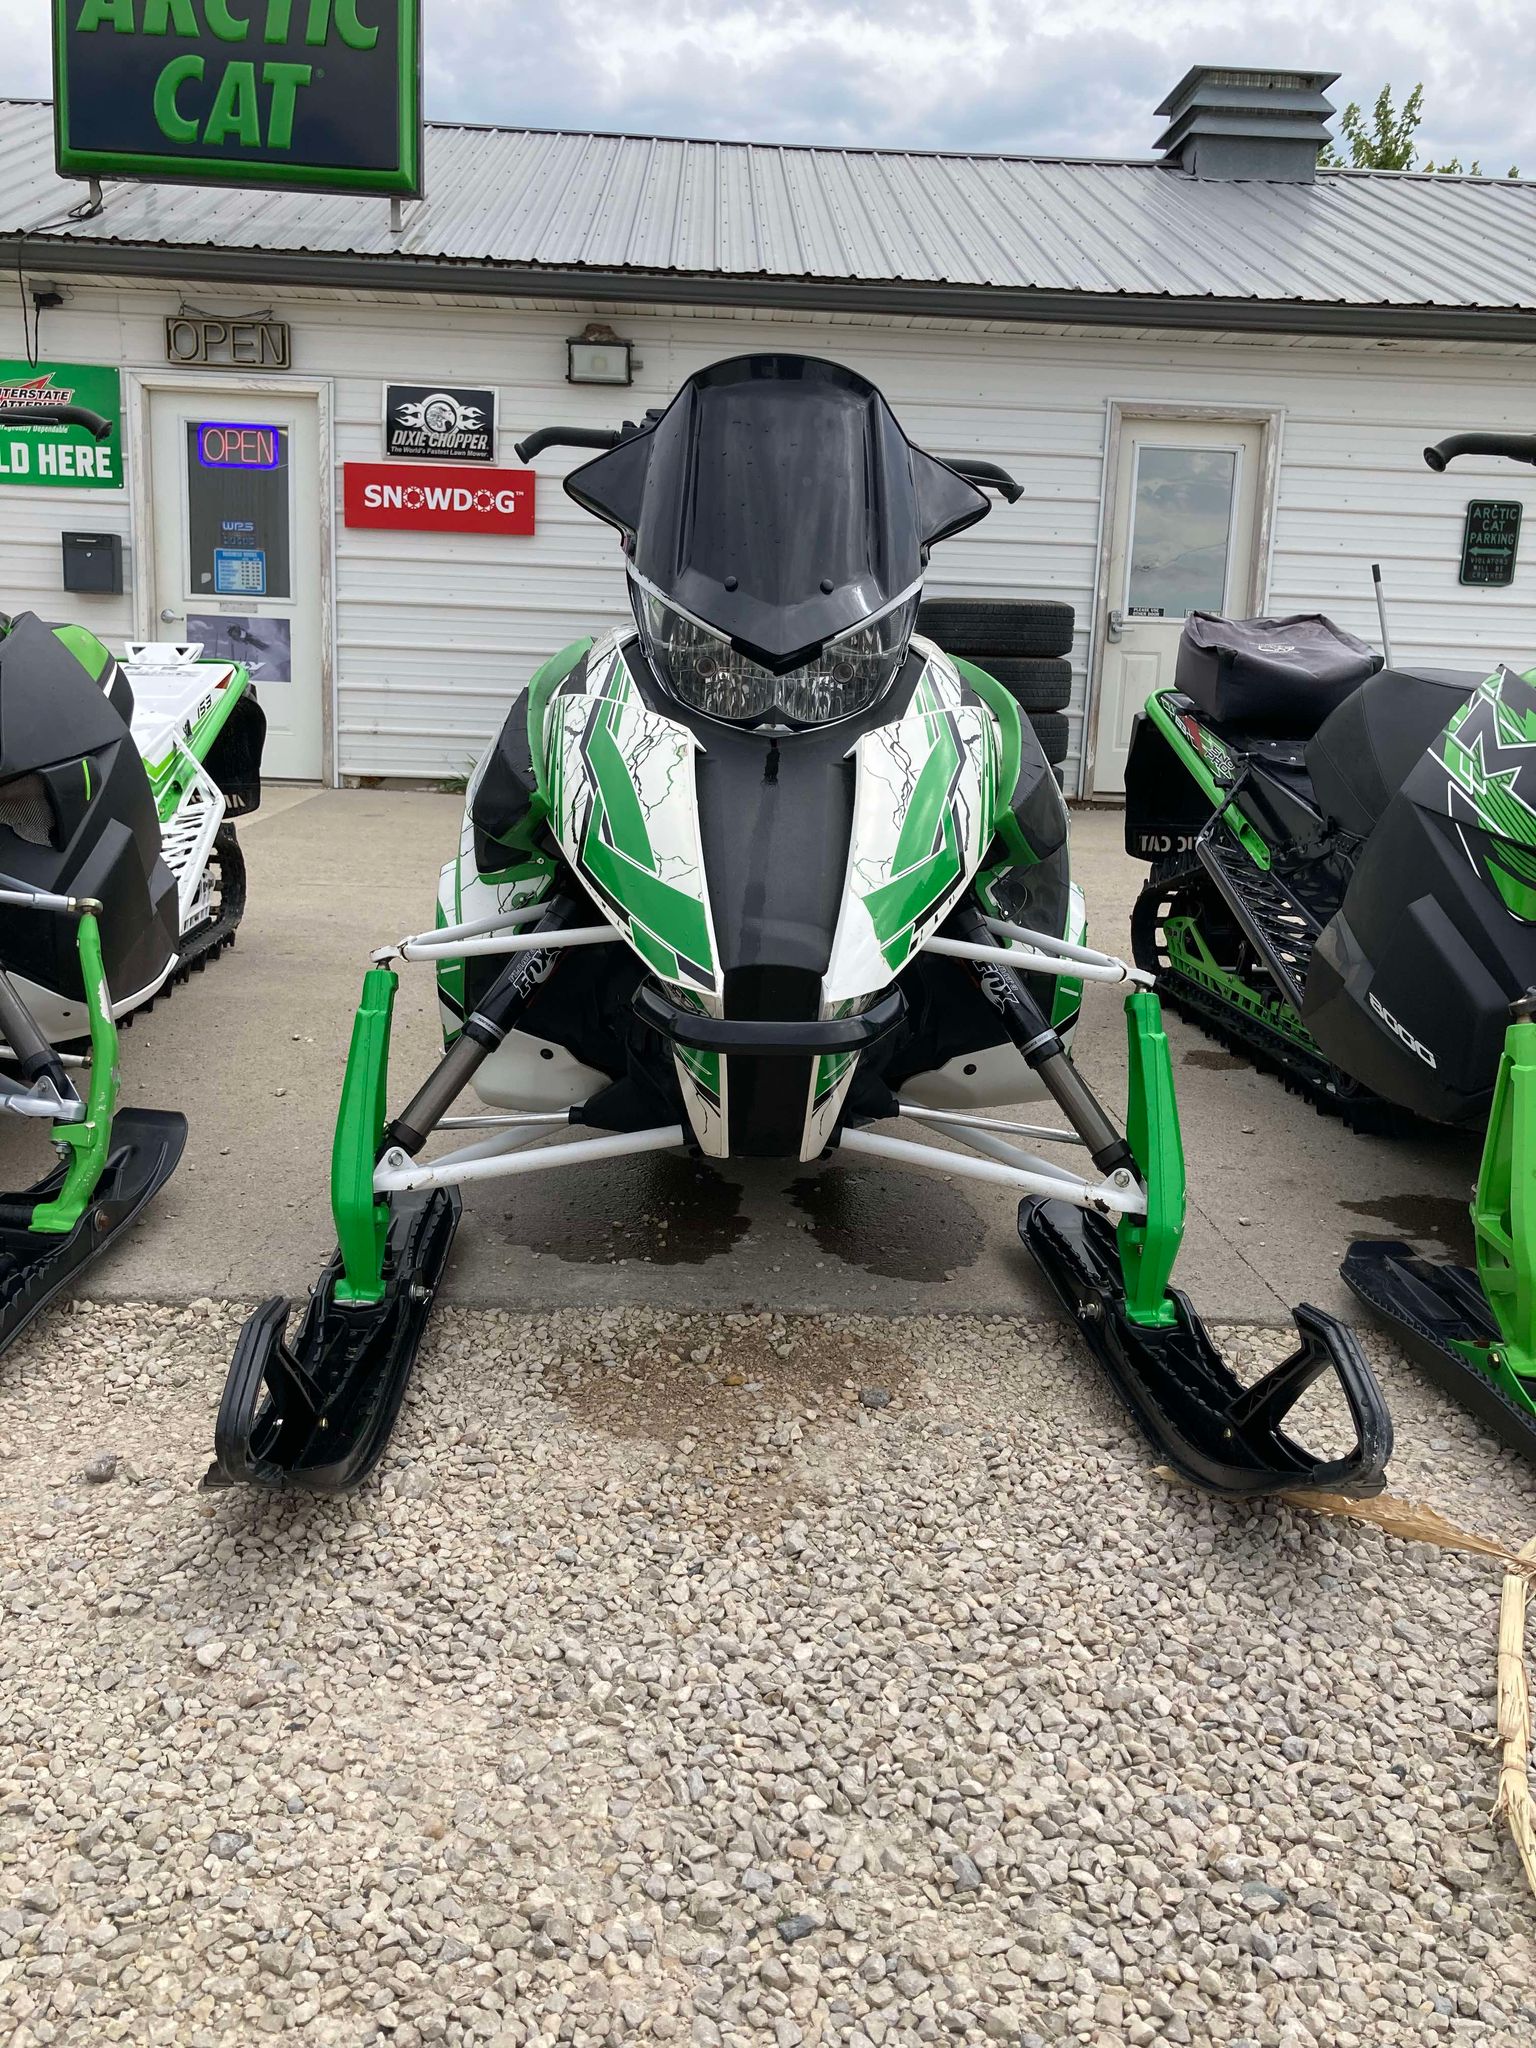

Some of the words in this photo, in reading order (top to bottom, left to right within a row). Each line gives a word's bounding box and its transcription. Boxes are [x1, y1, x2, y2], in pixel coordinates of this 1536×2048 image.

[153, 54, 313, 150] CAT
[171, 320, 284, 364] OPEN
[0, 388, 69, 400] TERSTATE
[204, 429, 274, 464] OPEN
[392, 430, 427, 447] DIXIE
[428, 432, 489, 450] CHOPPER
[38, 443, 113, 478] HERE
[1473, 507, 1518, 520] ARCTIC
[1482, 519, 1506, 532] CAT
[1469, 532, 1515, 545] PARKING
[197, 694, 212, 719] 153
[1369, 992, 1437, 1068] 8000
